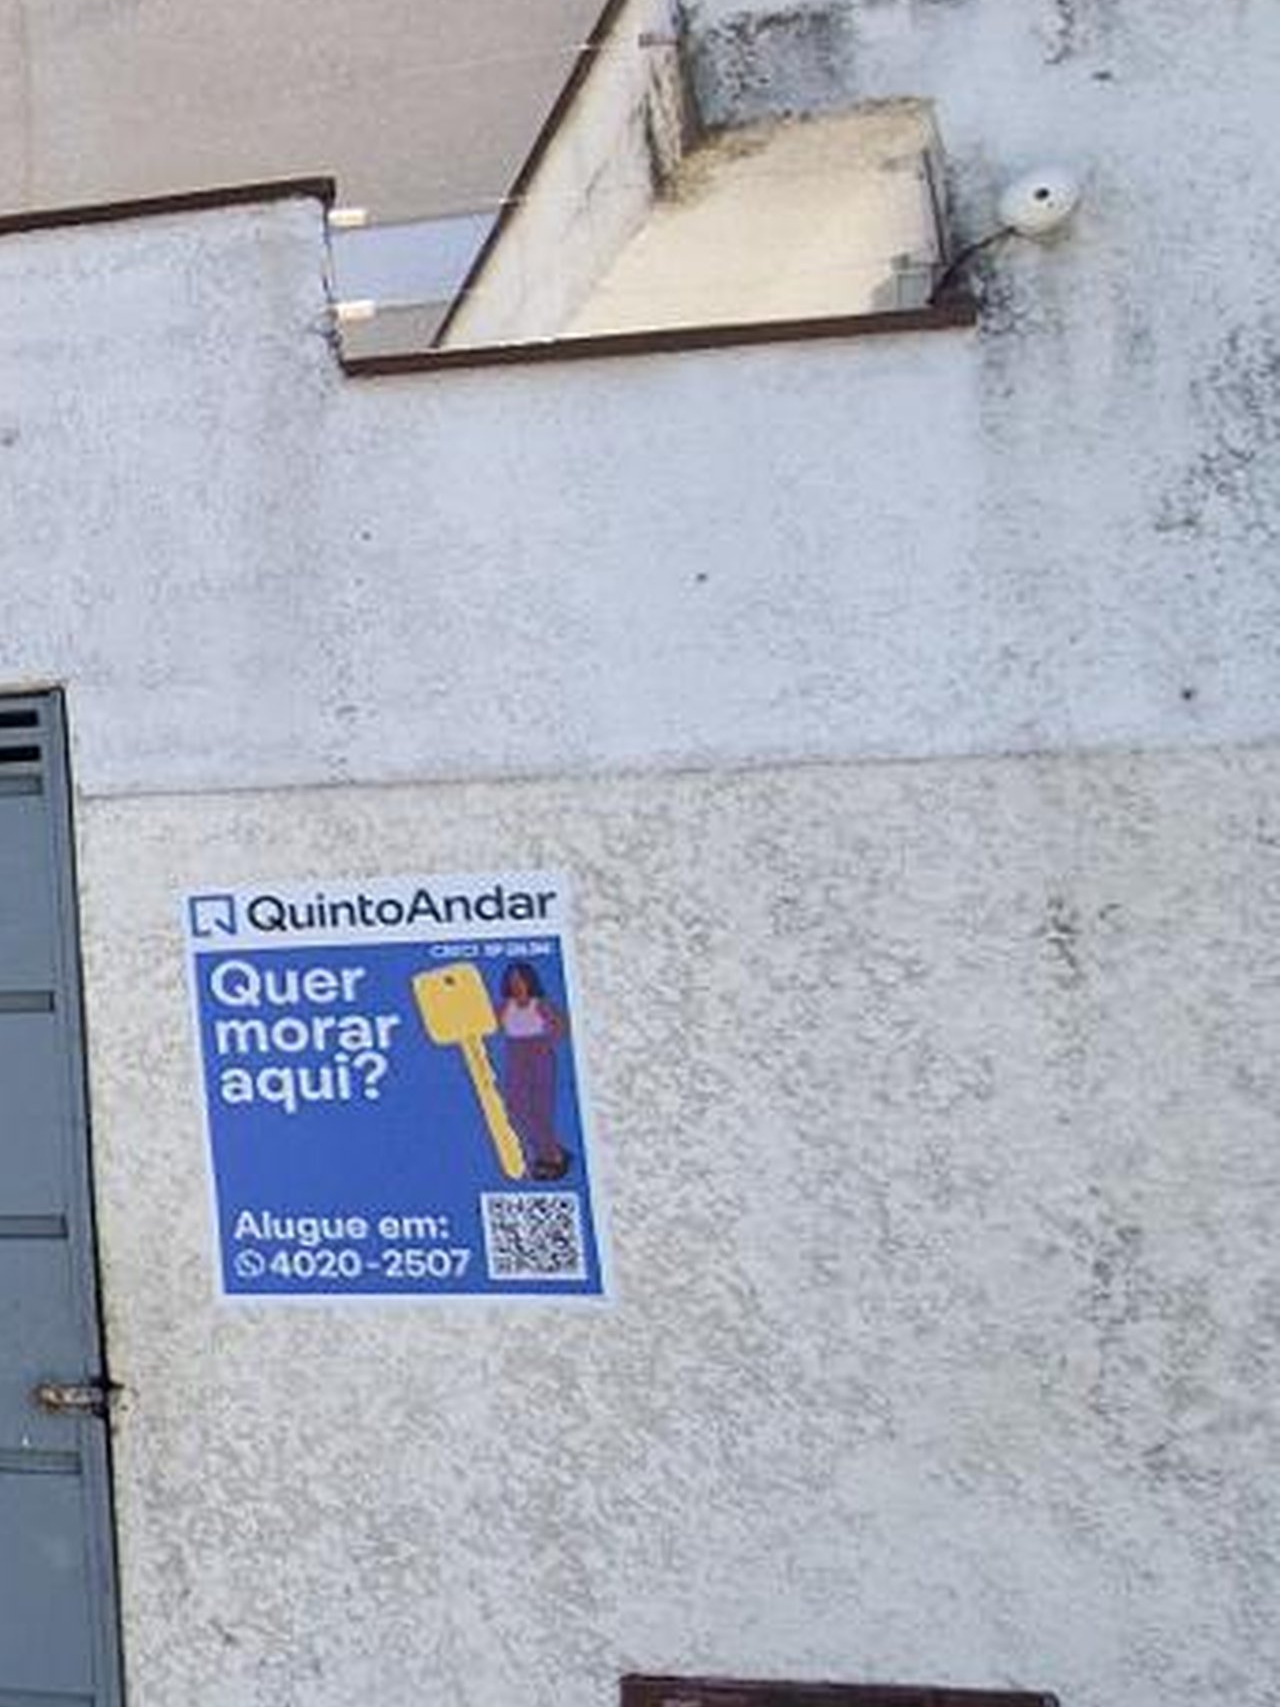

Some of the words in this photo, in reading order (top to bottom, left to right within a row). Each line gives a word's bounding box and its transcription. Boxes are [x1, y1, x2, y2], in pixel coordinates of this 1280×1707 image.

[247, 886, 557, 932] QuintoAndar
[210, 960, 366, 1006] Quer
[215, 1015, 401, 1054] morar
[220, 1051, 389, 1114] aqui?
[234, 1210, 368, 1246] Alugue
[378, 1215, 450, 1240] em:
[270, 1248, 471, 1278] 4020-2507
